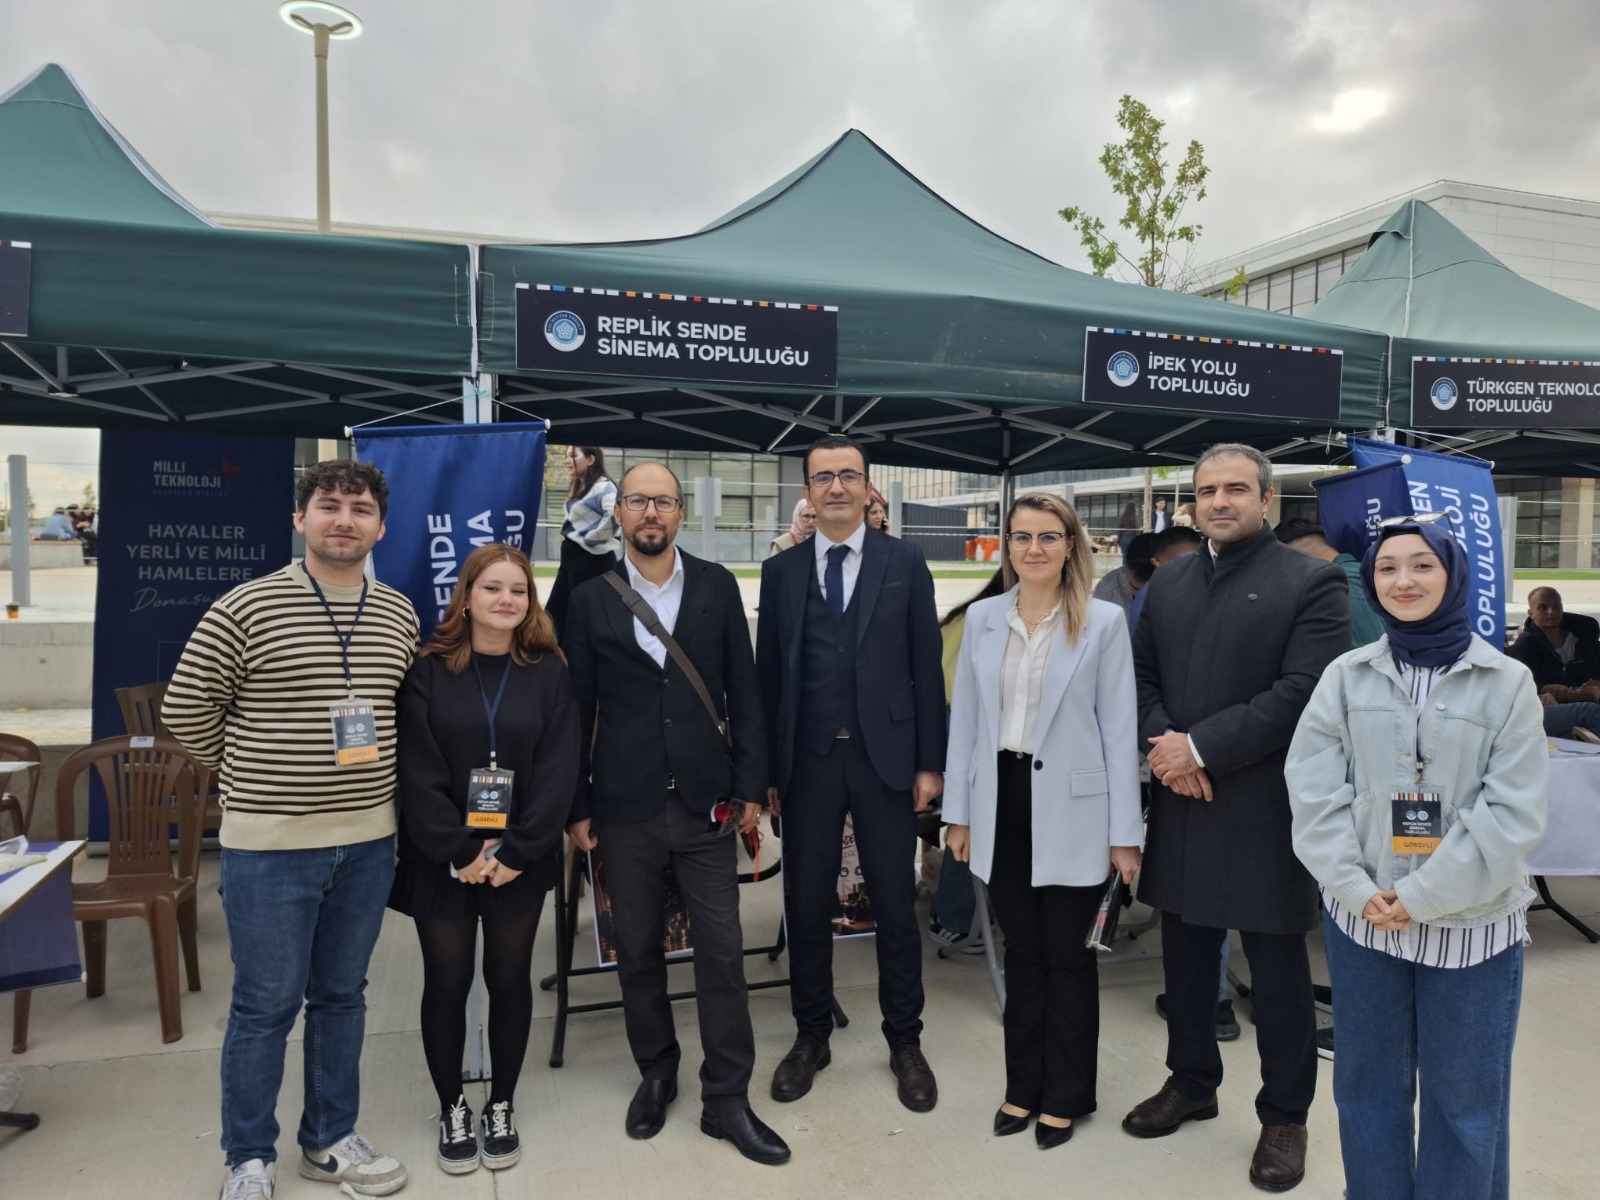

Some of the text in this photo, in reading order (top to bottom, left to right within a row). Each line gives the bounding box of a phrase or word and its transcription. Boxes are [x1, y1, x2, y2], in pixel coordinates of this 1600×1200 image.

[597, 315, 672, 337] REPLİK
[677, 322, 747, 342] SENDE
[597, 334, 809, 367] SİNEMA TOPLULUĞU
[1147, 351, 1186, 373] İPEK
[1190, 359, 1237, 376] YOLU
[1147, 375, 1250, 398] TOPLULUĞU
[1466, 377, 1534, 395] TÜRKGEN
[1466, 397, 1552, 413] TOPLULUĞU
[148, 523, 246, 540] HAYALLER
[126, 542, 181, 560] YERLİ
[185, 546, 210, 560] VE
[138, 566, 253, 582] HAMLELERE
